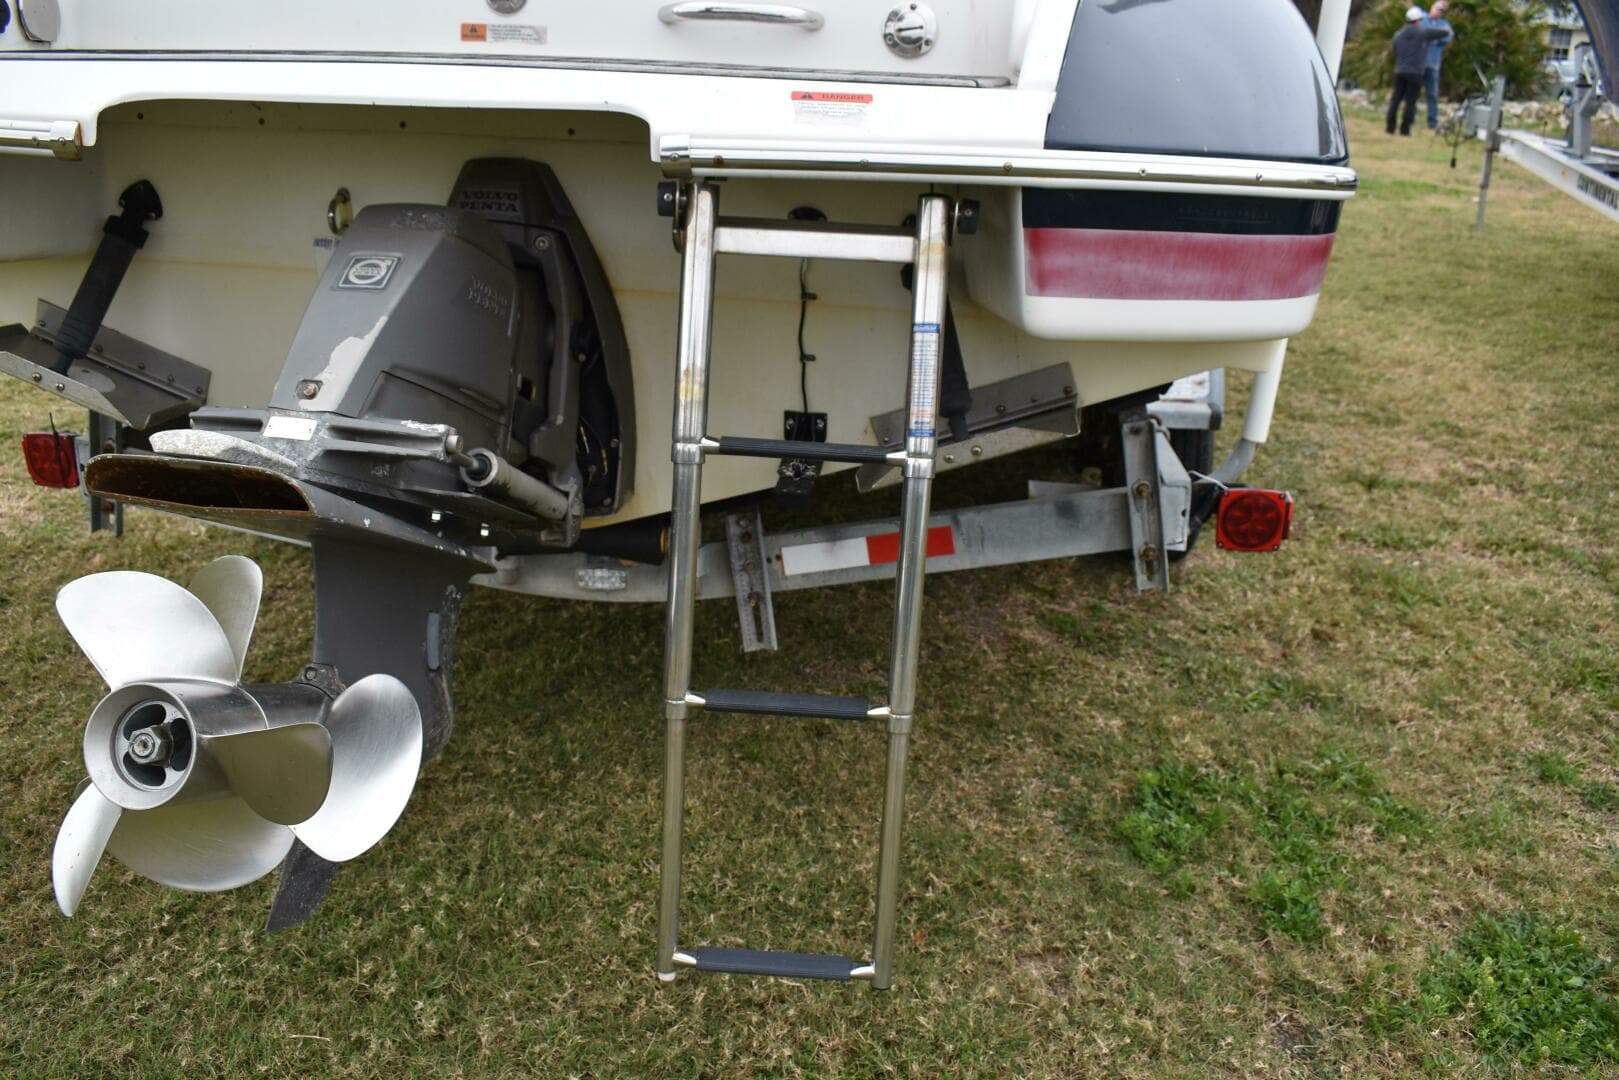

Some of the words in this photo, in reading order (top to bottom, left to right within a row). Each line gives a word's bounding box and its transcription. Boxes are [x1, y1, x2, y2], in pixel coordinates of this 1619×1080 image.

[822, 93, 864, 101] DANGER
[463, 190, 519, 201] VOLVO
[459, 200, 520, 213] PENTA
